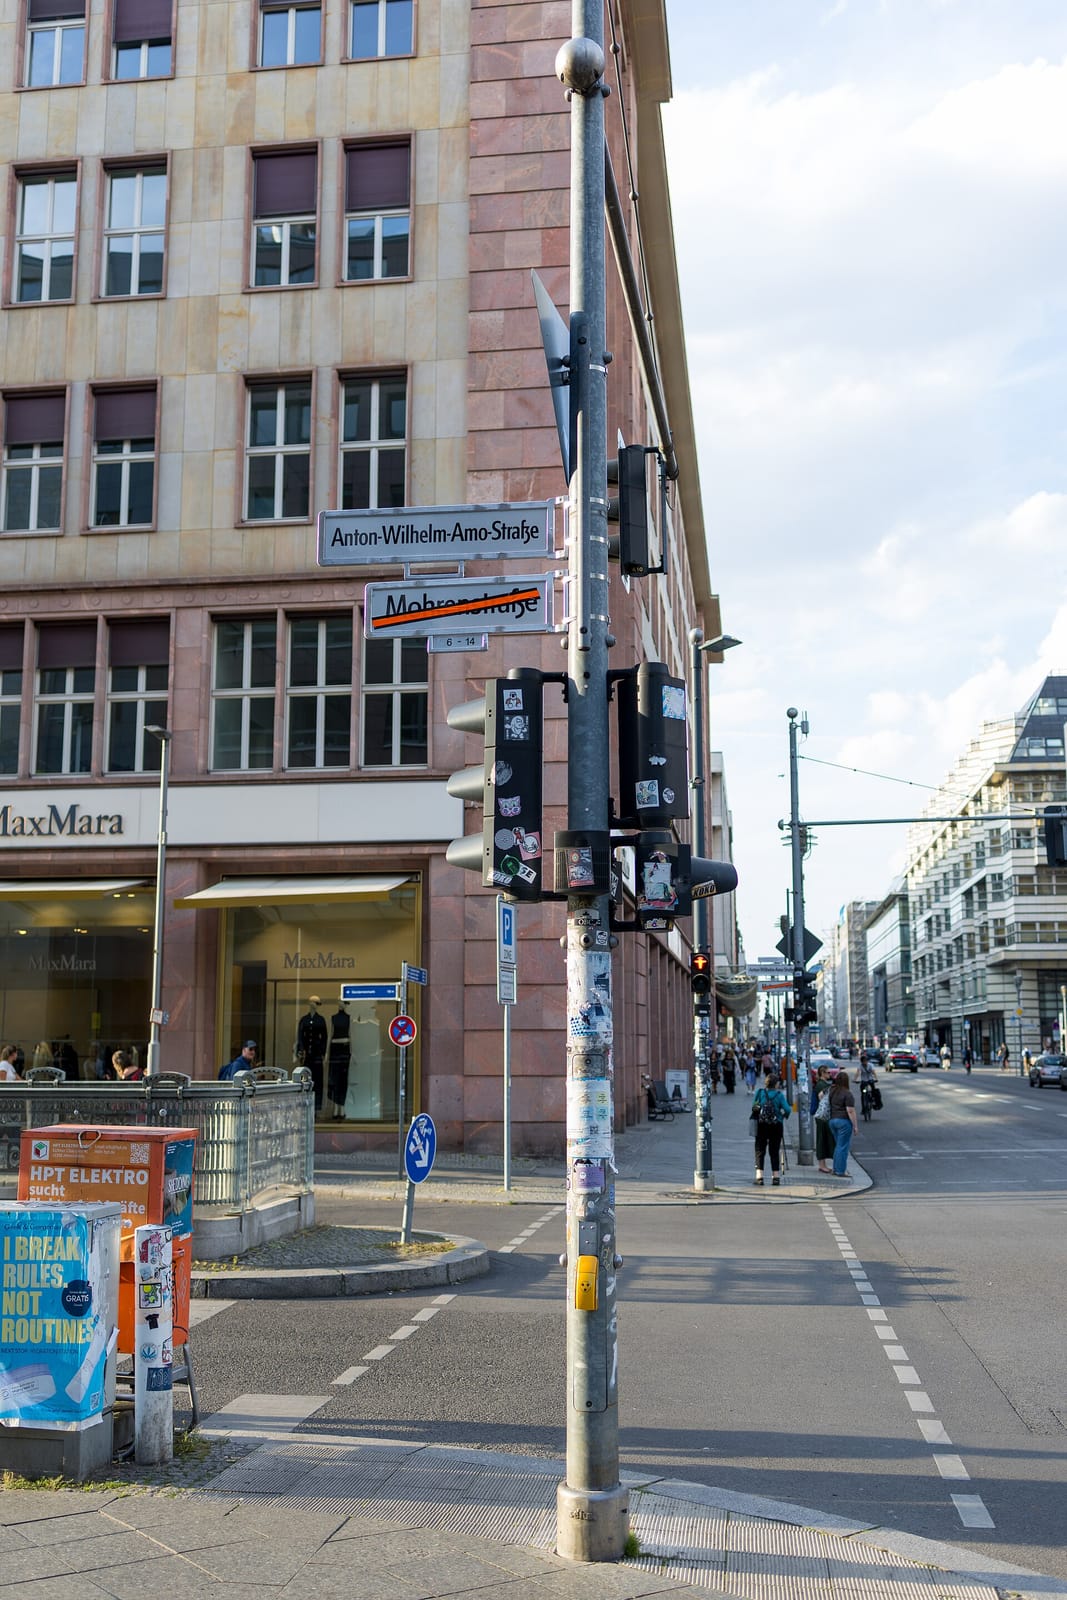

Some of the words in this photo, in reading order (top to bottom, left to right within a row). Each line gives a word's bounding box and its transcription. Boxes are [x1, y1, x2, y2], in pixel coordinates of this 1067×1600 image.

[331, 520, 539, 547] Anton-Wilhelm-Amo-Straße
[446, 637, 453, 647] 6
[466, 637, 475, 646] 14
[29, 954, 97, 970] MaxMara
[284, 952, 355, 968] MaxMara
[30, 1165, 66, 1183] HPT
[69, 1168, 149, 1185] ELEKTRO
[29, 1184, 66, 1197] sucht
[3, 1236, 11, 1261] I
[15, 1236, 81, 1261] BREAK
[3, 1263, 69, 1289] RULES.
[2, 1290, 43, 1316] NOT
[1, 1317, 95, 1344] ROUTINES
